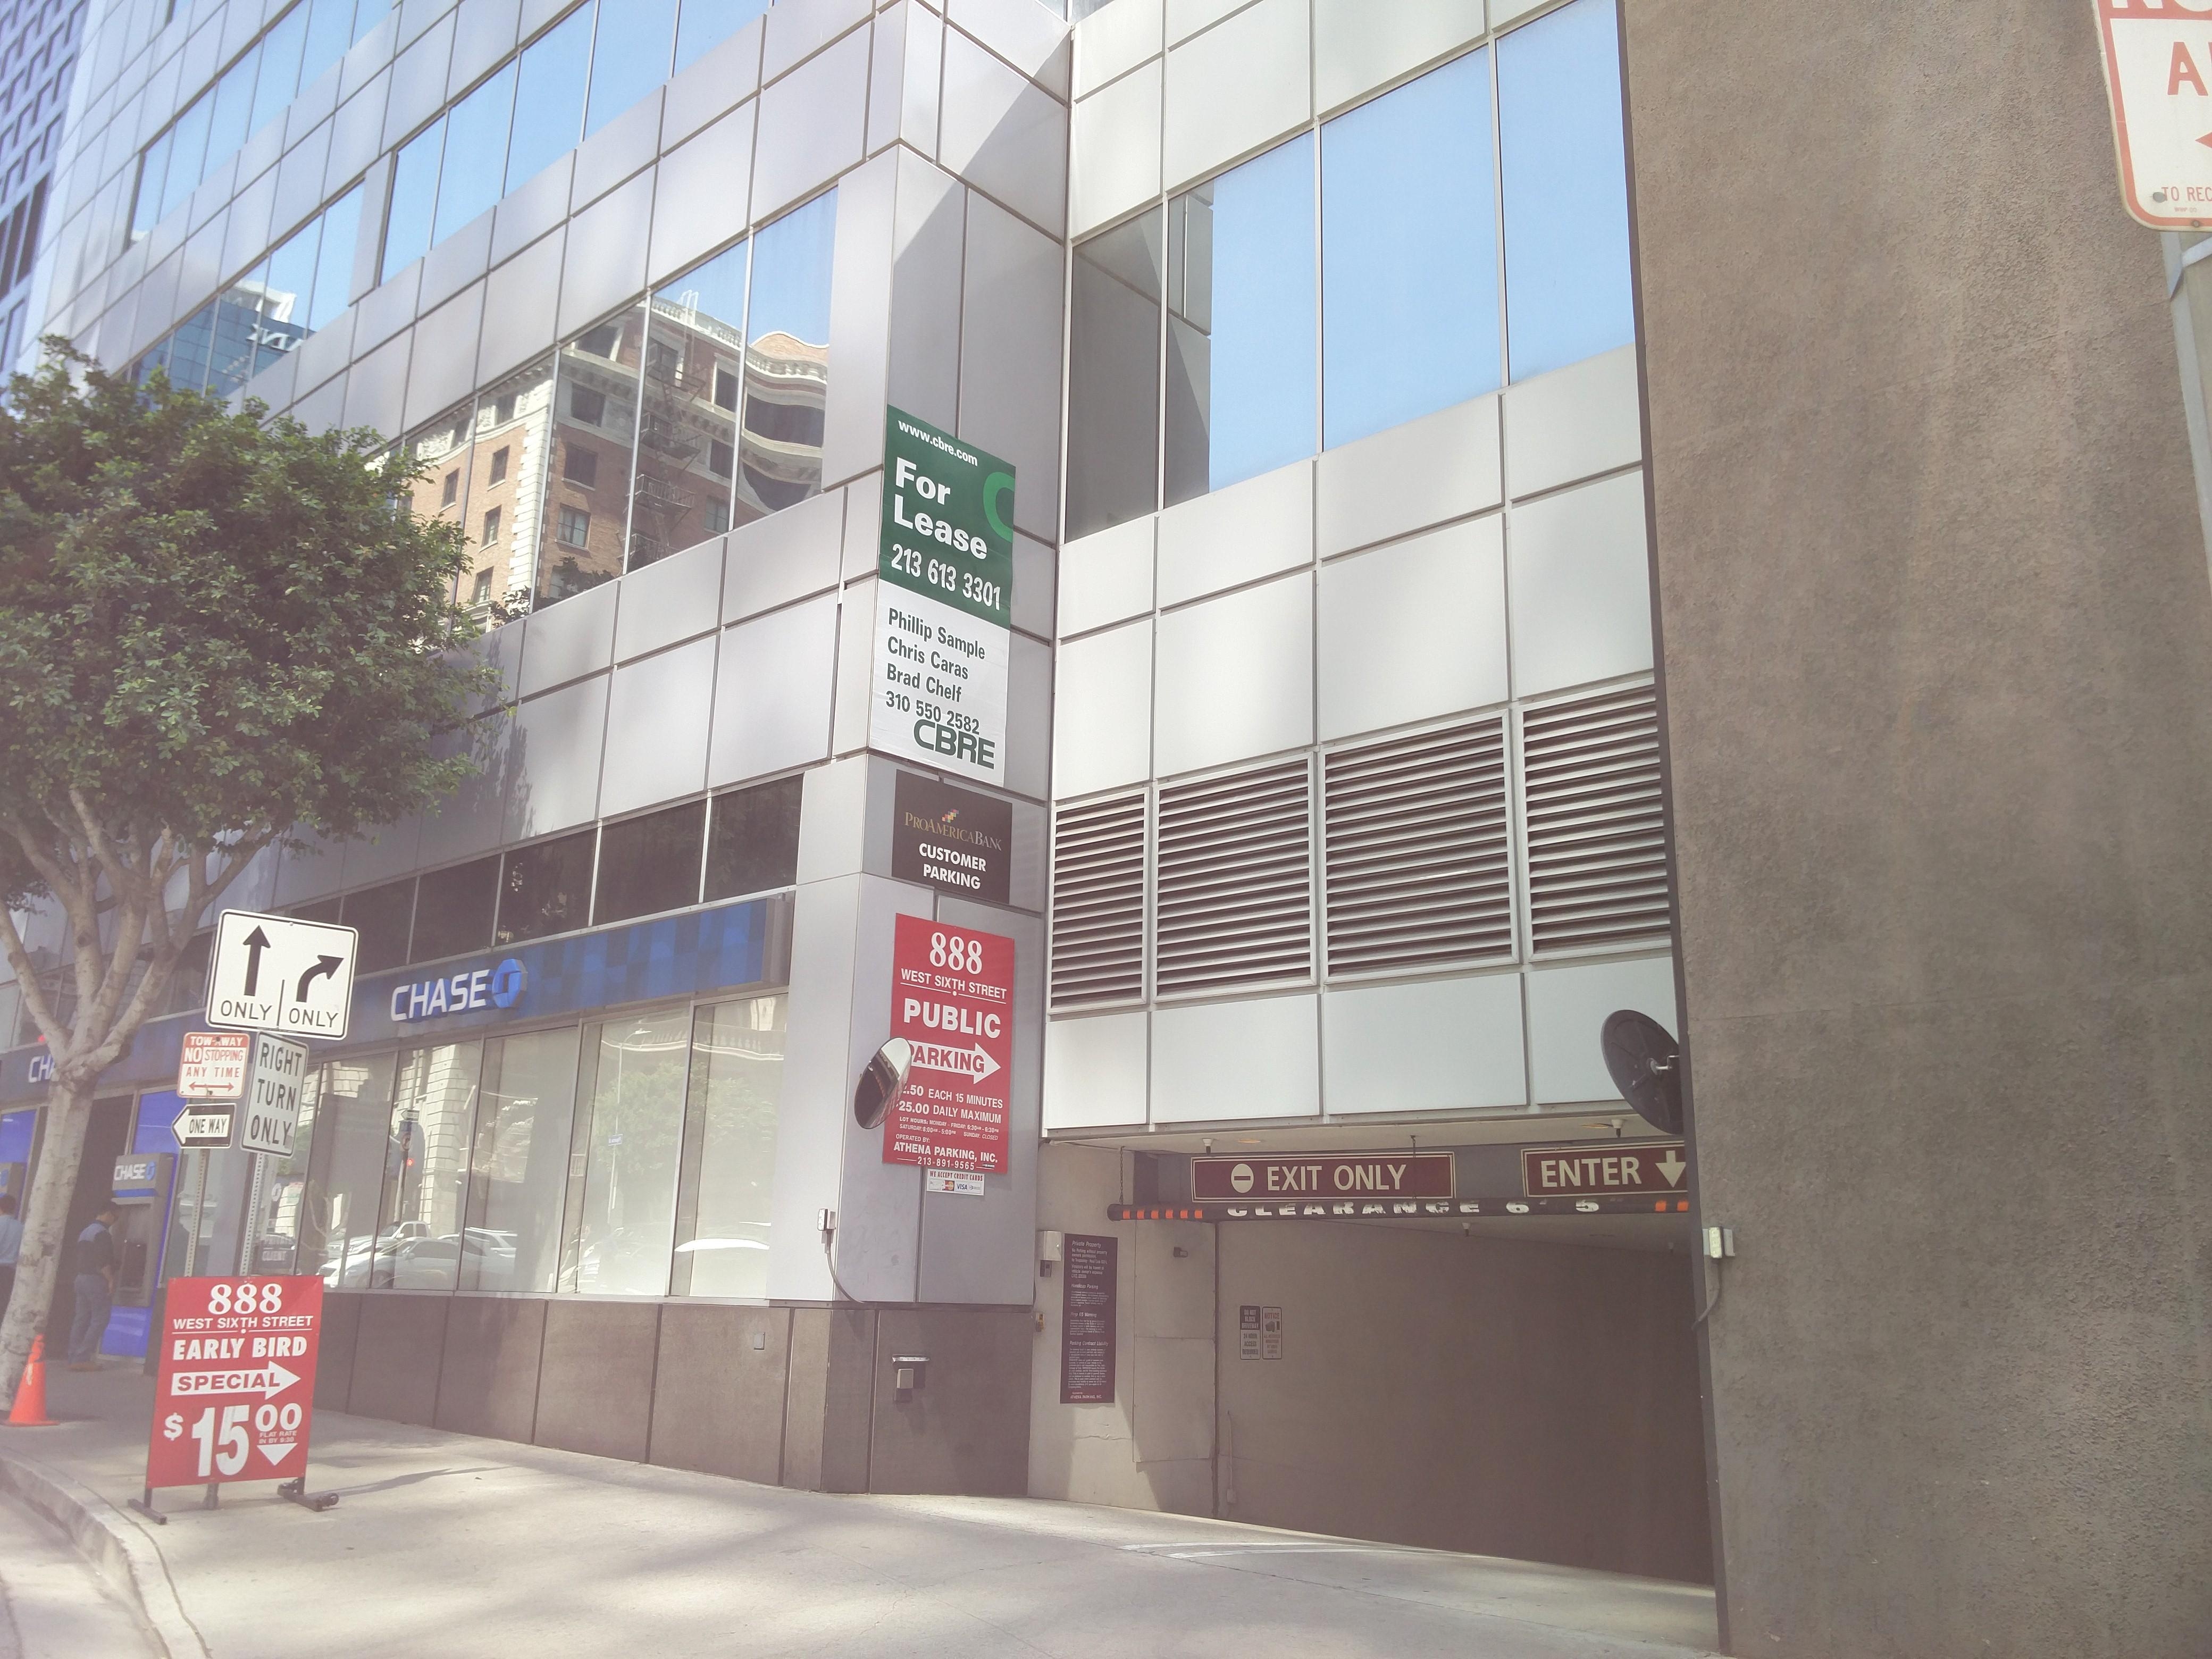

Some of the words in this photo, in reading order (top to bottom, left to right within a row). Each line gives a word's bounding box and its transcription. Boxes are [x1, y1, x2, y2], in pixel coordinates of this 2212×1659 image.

[2161, 186, 2179, 202] TO
[898, 420, 978, 467] www.cbre.com
[895, 457, 951, 505] For
[894, 494, 987, 560] Lease
[891, 543, 922, 577] 213
[927, 559, 957, 592] 613
[962, 573, 1001, 611] 3301
[889, 607, 932, 642] Phillip
[937, 626, 985, 660] Sample
[887, 636, 925, 664] Chris
[931, 651, 969, 680] Caras
[887, 663, 920, 690] Brad
[926, 676, 962, 703] Chelf
[886, 690, 910, 713] 310
[916, 700, 941, 723] 550
[946, 710, 980, 735] 2582
[914, 719, 995, 770] CBRE
[919, 842, 987, 872] CUSTOMER
[923, 863, 982, 890] PARKING
[929, 932, 983, 975] 888
[390, 969, 491, 1021] CHASE
[901, 968, 932, 984] WEST
[934, 975, 965, 991] SIXTH
[968, 982, 1007, 1000] STREET
[221, 1000, 272, 1020] ONLY
[289, 1008, 339, 1028] ONLY
[903, 998, 1001, 1039] PUBLIC
[184, 1047, 202, 1062] NO
[205, 1049, 244, 1061] STOPPING
[259, 1042, 303, 1077] RIGHT
[186, 1067, 207, 1077] ANY
[214, 1067, 240, 1078] TIME
[257, 1078, 297, 1112] TURN
[928, 1088, 952, 1101] EACH
[956, 1093, 964, 1102] 15
[966, 1094, 1003, 1109] MINUTES
[189, 1118, 206, 1134] ONE
[208, 1118, 227, 1134] WAY
[933, 1105, 958, 1117] DAILY
[961, 1109, 1002, 1124] MAXIMUM
[250, 1115, 292, 1146] ONLY
[893, 1142, 931, 1155] ATHENA
[934, 1146, 977, 1162] PARKING,
[980, 1152, 998, 1163] INC.
[114, 1163, 146, 1180] CHASE
[1267, 1166, 1322, 1191] EXIT
[1334, 1164, 1406, 1190] ONLY
[1541, 1157, 1642, 1188] ENTER
[1227, 1200, 1480, 1217] CLEARANCE
[208, 1283, 282, 1315] 888
[173, 1318, 213, 1329] WEST
[217, 1317, 258, 1329] SIXTH
[262, 1315, 314, 1328] STREET
[172, 1337, 245, 1361] EARLY
[252, 1336, 307, 1358] BIRD
[177, 1372, 281, 1392] SPECIAL
